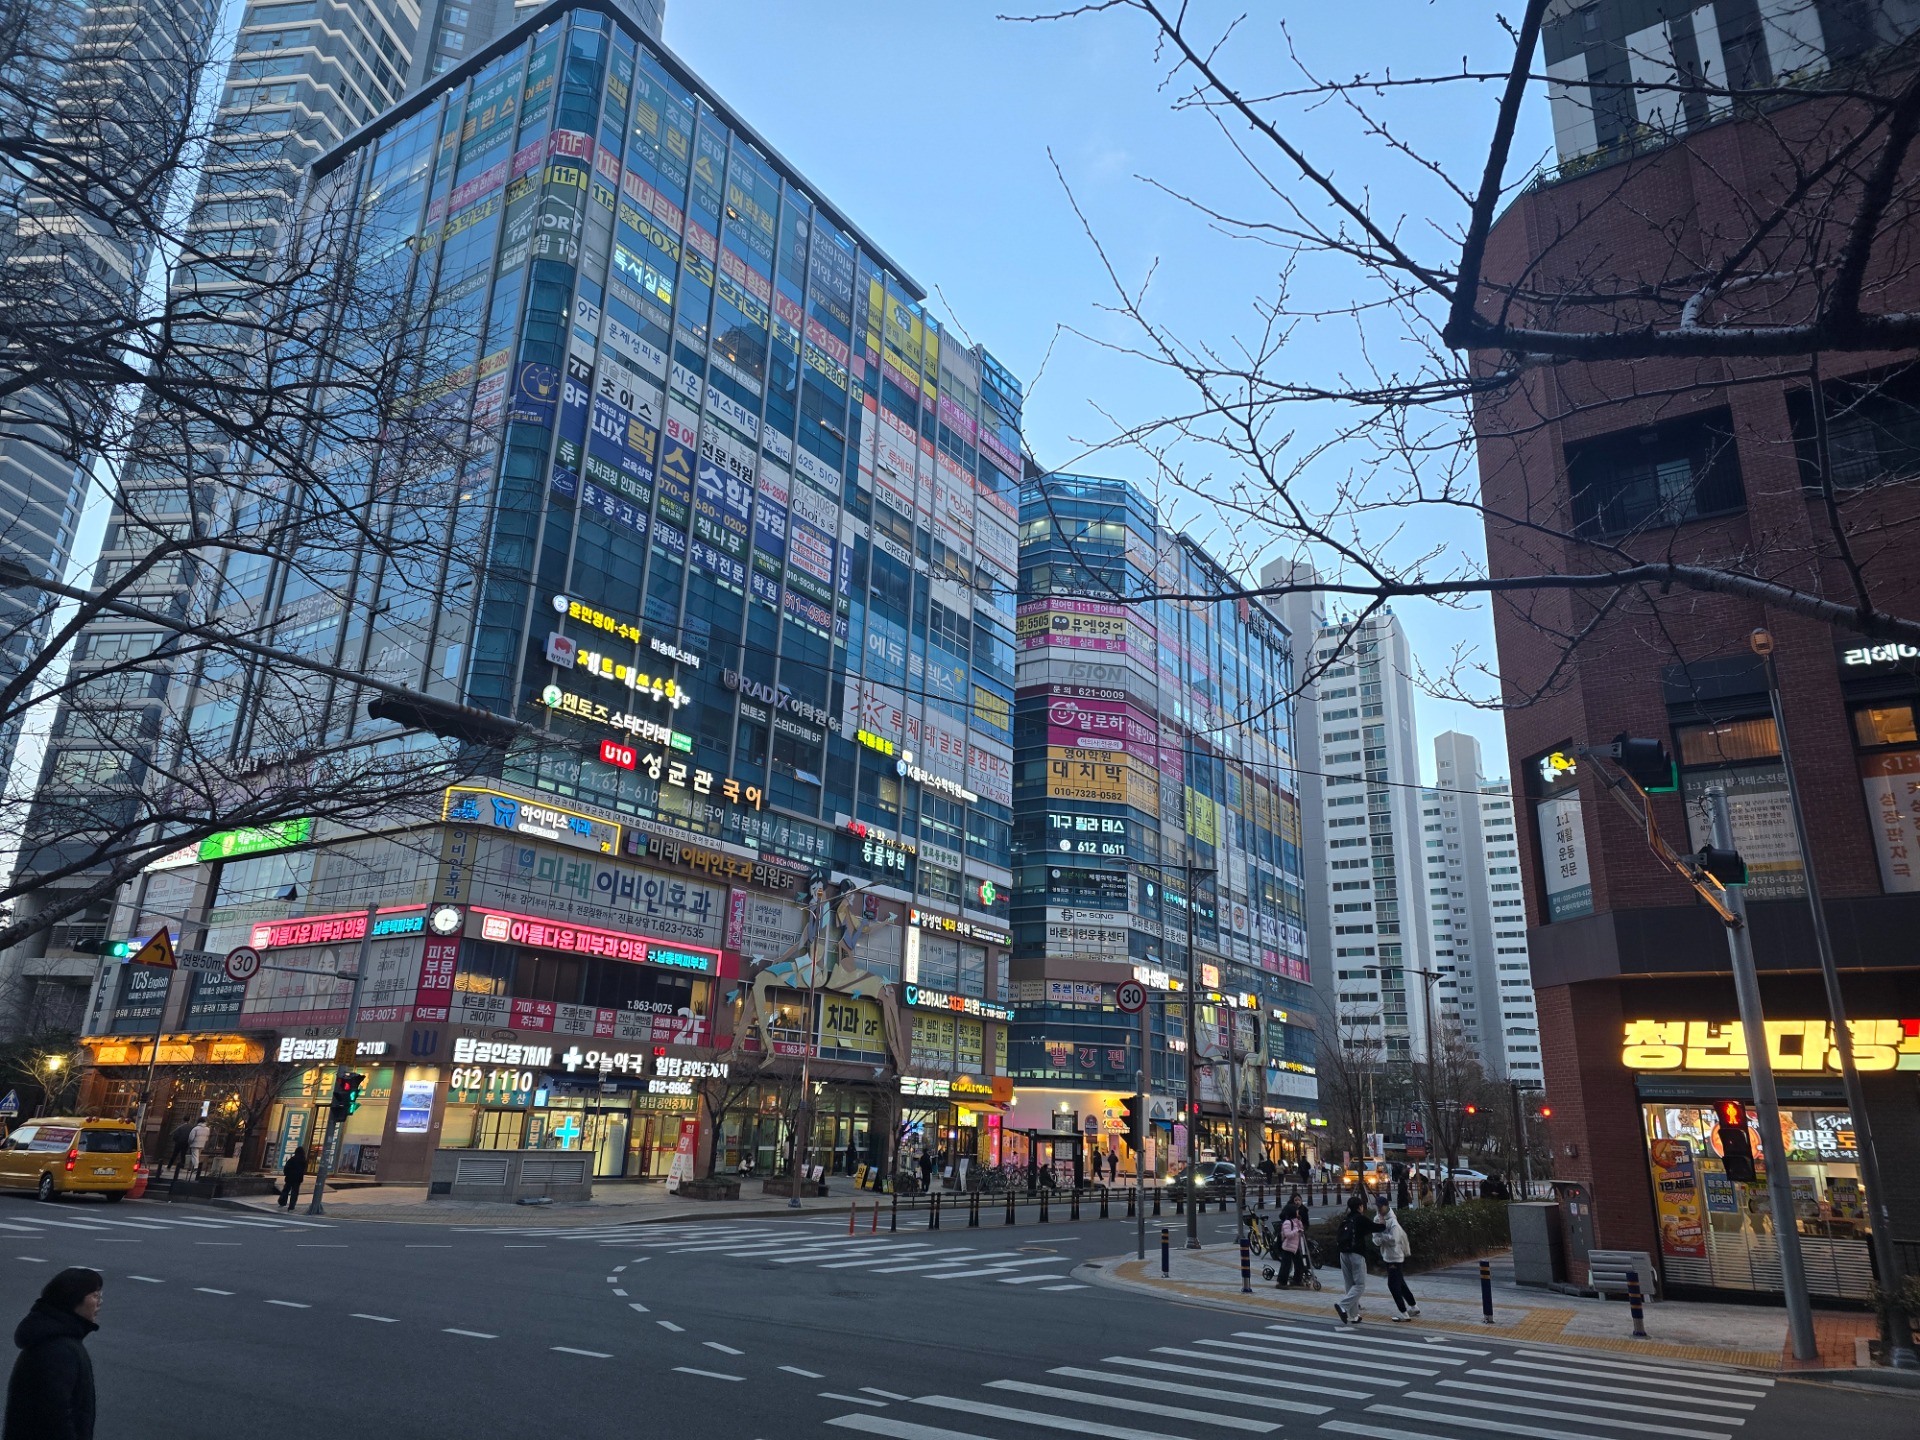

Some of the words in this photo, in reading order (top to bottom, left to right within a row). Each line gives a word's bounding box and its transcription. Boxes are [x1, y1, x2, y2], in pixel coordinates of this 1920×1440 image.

[560, 134, 583, 152] 11F
[555, 167, 577, 184] 11F
[597, 152, 620, 184] 11F
[593, 183, 615, 212] 11F
[637, 219, 680, 262] COX
[614, 249, 657, 294] 독서실
[569, 358, 590, 379] 7F
[577, 302, 599, 323] 9F
[608, 322, 662, 366] 문제성피부
[672, 364, 699, 398] 시온
[707, 388, 759, 441] 에스테틱
[563, 383, 589, 409] 8F
[600, 377, 653, 422] 초이스
[667, 418, 694, 447] 영어
[592, 411, 626, 446] LUX
[698, 466, 752, 520] 수학
[698, 516, 742, 554] 책나무
[884, 540, 911, 566] GREEN
[839, 546, 850, 595] LUX
[691, 543, 744, 585] 수학전문
[753, 573, 777, 602] 학원
[836, 619, 848, 636] 7F
[1050, 600, 1075, 611] 원어민
[1077, 603, 1090, 611] 1:1
[569, 600, 642, 644] 윤민영어·수학
[1072, 618, 1123, 635] 뮤엠영어
[651, 637, 700, 670] 비송에스테틱
[1031, 636, 1045, 647] 진로
[1055, 635, 1071, 646] 적성
[1079, 638, 1095, 648] 심리
[1105, 640, 1121, 650] 검사
[1067, 663, 1122, 682] ISION
[739, 674, 790, 712] RADIX
[791, 699, 827, 727] 어학원
[828, 716, 843, 734] 6F
[1053, 684, 1072, 696] 문의
[1078, 687, 1125, 700] 621-0009
[564, 692, 609, 725] 멘토즈
[610, 711, 672, 747] 스터디카페
[741, 702, 767, 723] 멘토즈
[774, 717, 811, 741] 스터디카페
[812, 730, 822, 744] 5F
[1077, 712, 1125, 733] 알로하
[1127, 719, 1157, 749] 산부인과
[605, 744, 633, 765] U10
[1064, 748, 1112, 763] 영어학원
[642, 752, 714, 795] 성균관
[723, 777, 763, 811] 국어
[1052, 760, 1123, 783] 대치박
[1054, 787, 1122, 801] 010-7328-0582
[1687, 781, 1703, 791] 1:1
[730, 811, 772, 839] 전문학원
[1048, 814, 1072, 830] 기구
[1075, 816, 1125, 834] 필라테스
[1555, 812, 1571, 827] 1:1
[601, 841, 612, 853] 2F
[862, 842, 906, 871] 동물병원
[1078, 842, 1097, 854] 612
[1102, 843, 1125, 855] 0611
[1558, 845, 1576, 862] 운동
[650, 838, 681, 865] 미래
[682, 846, 754, 884] 이비인후과
[754, 865, 781, 890] 의원
[781, 873, 794, 890] 3F
[1560, 861, 1578, 879] 전문
[538, 857, 593, 899] 미래
[596, 869, 713, 923] 이비인후과
[618, 913, 651, 929] 진료상담
[652, 917, 704, 939] T.623-7535
[1089, 912, 1115, 920] SONG
[1049, 926, 1127, 943] 바른체형운동센터
[232, 954, 253, 973] 30
[131, 970, 150, 990] TCS
[148, 976, 169, 989] English
[1075, 984, 1095, 995] 역사
[627, 999, 673, 1016] T.863-0075
[1122, 988, 1141, 1005] 30
[416, 1007, 447, 1020] 여드름
[826, 1003, 860, 1034] 치과
[865, 1020, 878, 1036] 2F
[673, 1007, 706, 1046] 2F
[453, 1037, 552, 1068] 탑공인중개사
[1622, 1018, 1903, 1072] 청년다방
[583, 1049, 643, 1074] 오늘약국
[1050, 1046, 1125, 1070] 빨간펜
[452, 1067, 483, 1090] 612
[488, 1069, 533, 1093] 1110
[1794, 1129, 1837, 1150] 명품
[1709, 1194, 1734, 1205] OPEN
